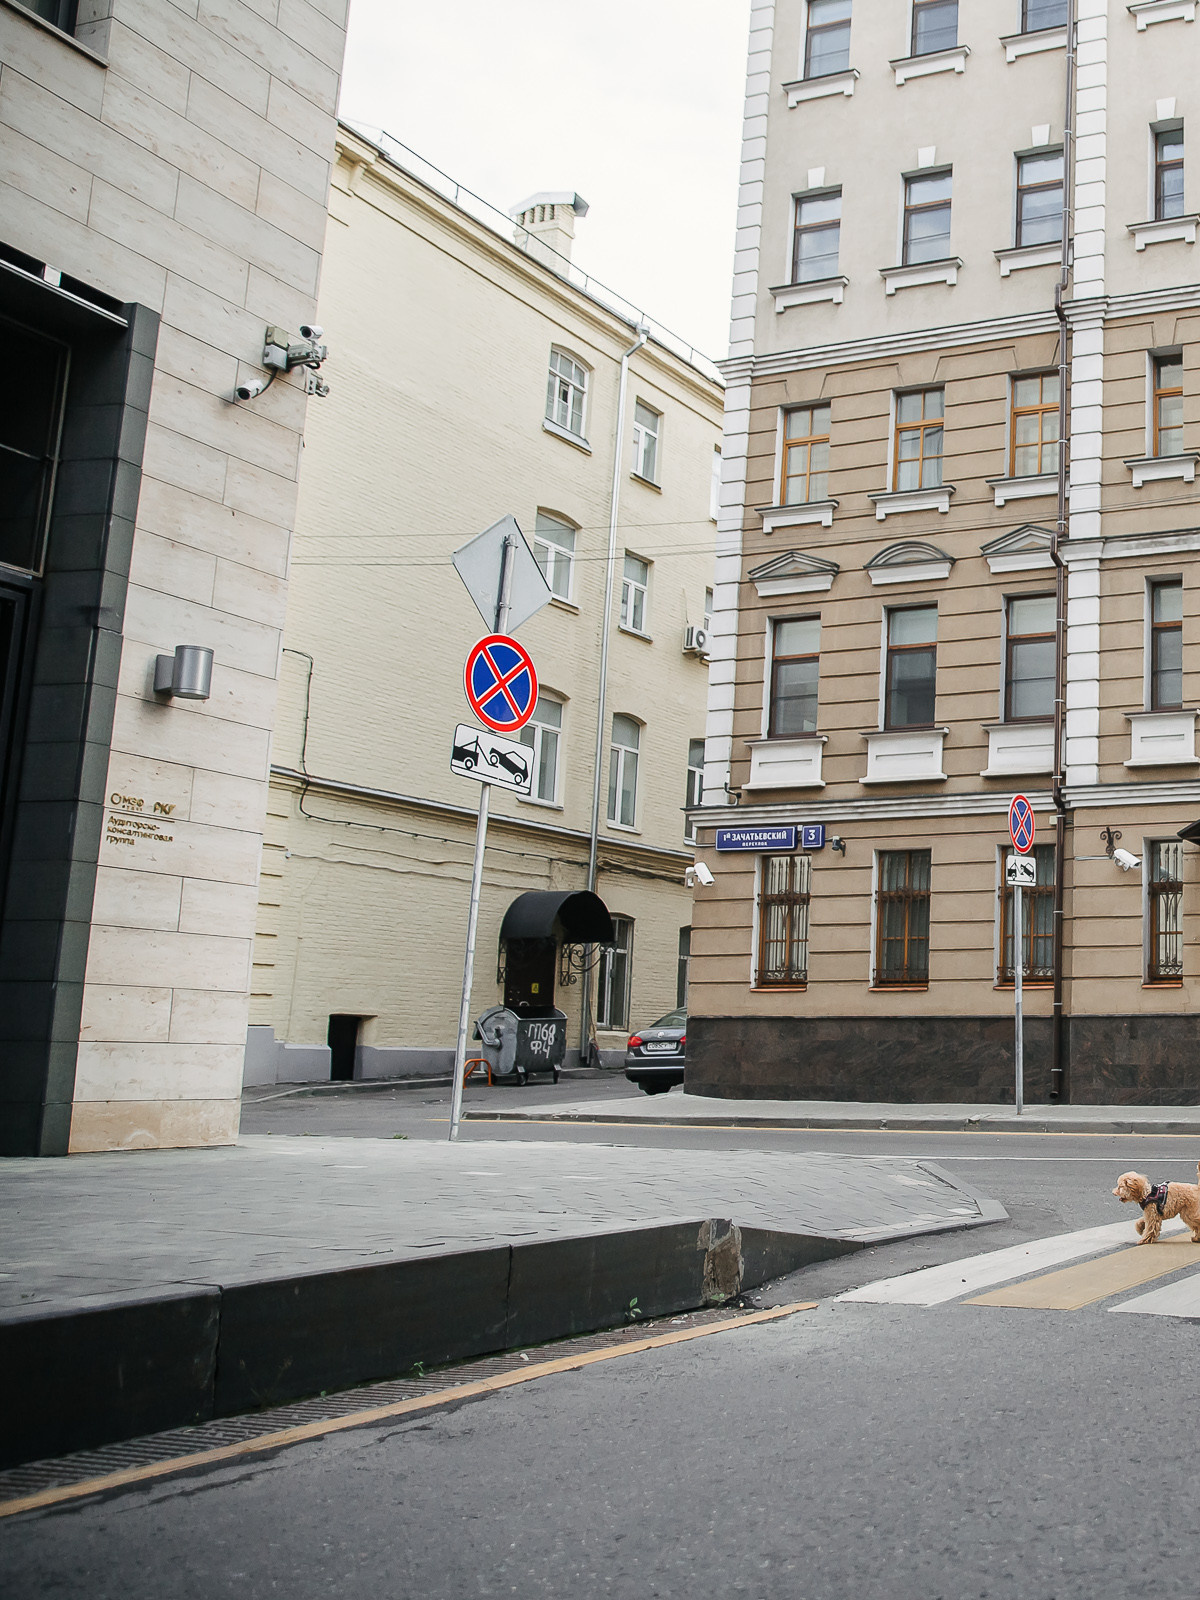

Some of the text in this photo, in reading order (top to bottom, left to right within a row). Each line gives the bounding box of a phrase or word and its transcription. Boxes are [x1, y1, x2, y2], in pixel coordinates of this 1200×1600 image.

[106, 835, 135, 845] группа
[731, 830, 787, 841] ЗАЧАТЬЕВСКИЙ
[808, 829, 816, 840] 3
